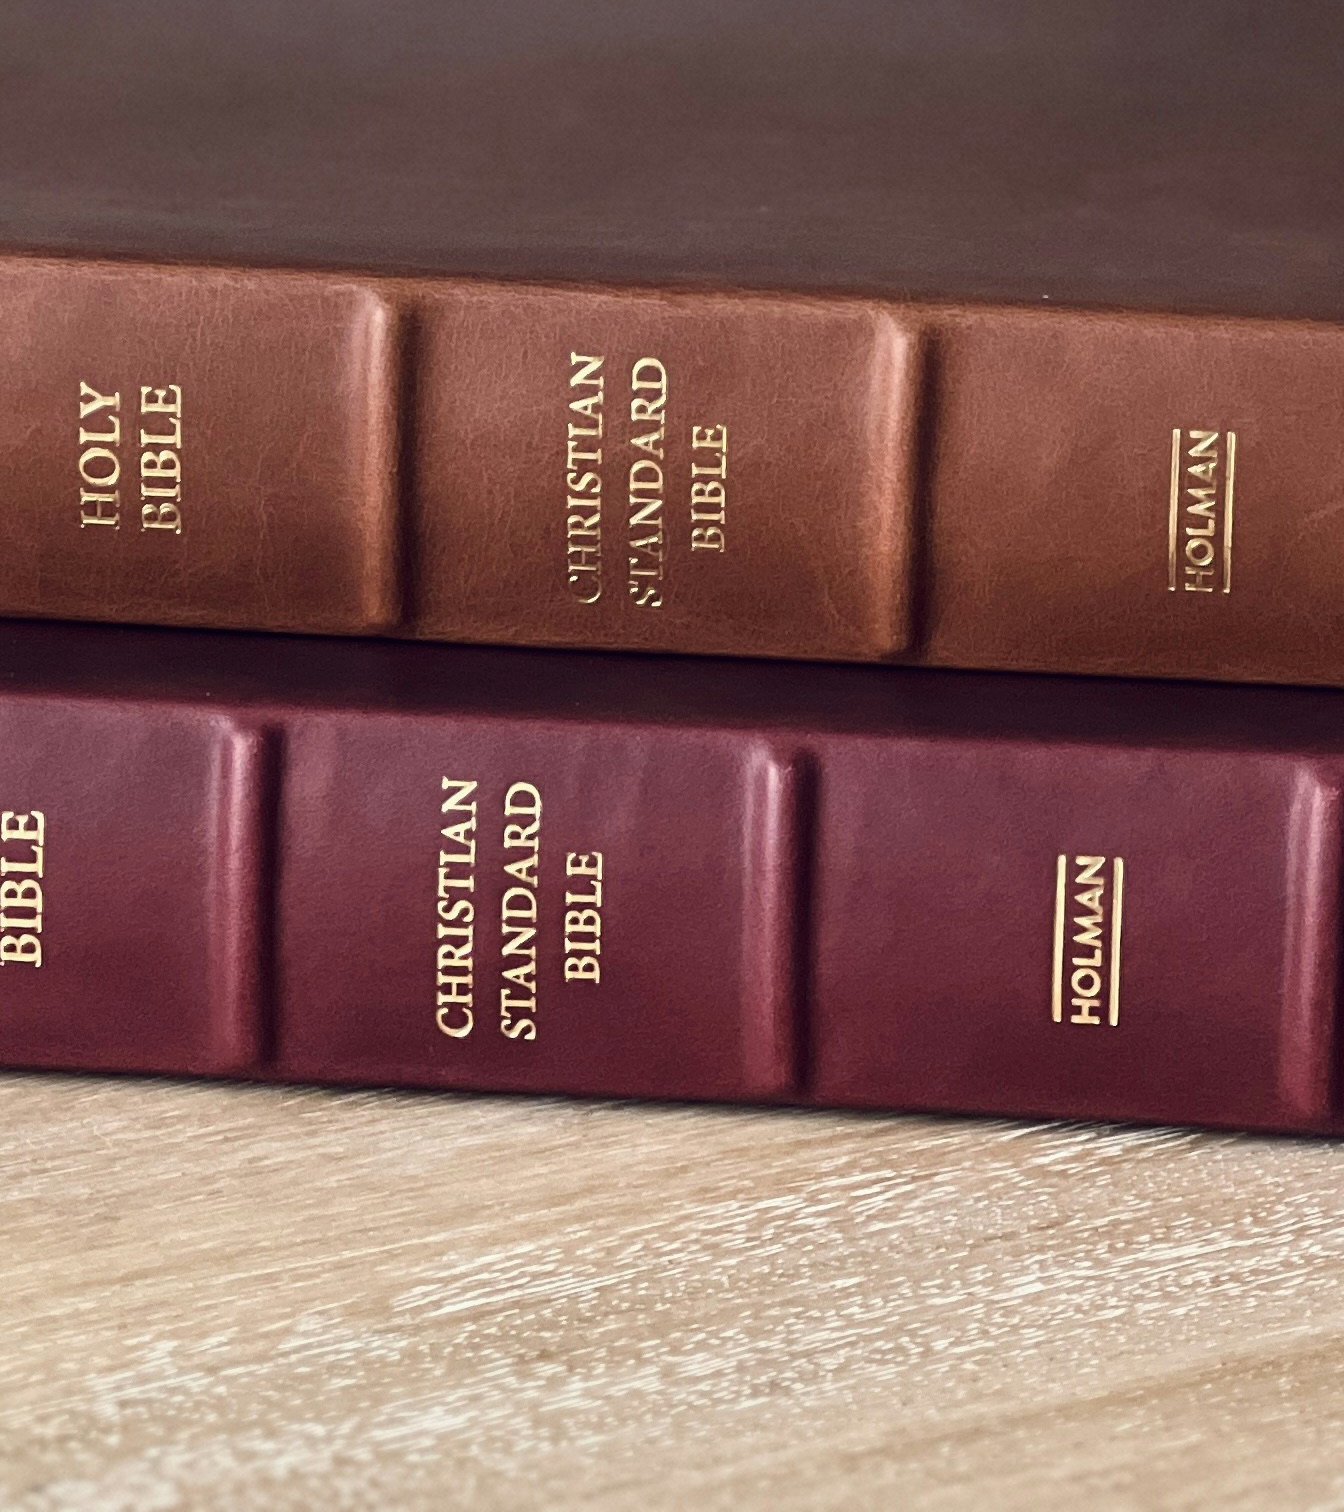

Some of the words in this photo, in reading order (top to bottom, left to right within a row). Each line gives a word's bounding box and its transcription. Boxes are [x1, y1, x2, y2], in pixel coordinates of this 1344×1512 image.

[78, 381, 121, 530] HOLY
[140, 384, 182, 535] BIBLE
[566, 351, 604, 604] CHRISTIAN
[629, 356, 667, 607] STANDARD
[690, 424, 727, 553] BIBLE
[1184, 430, 1219, 592] HOLMAN
[0, 810, 45, 968] BIBLE
[435, 775, 478, 1039] CHRISTIAN
[500, 781, 542, 1041] STANDARD
[564, 851, 603, 984] BIBLE
[1070, 855, 1106, 1025] HOLMAN
